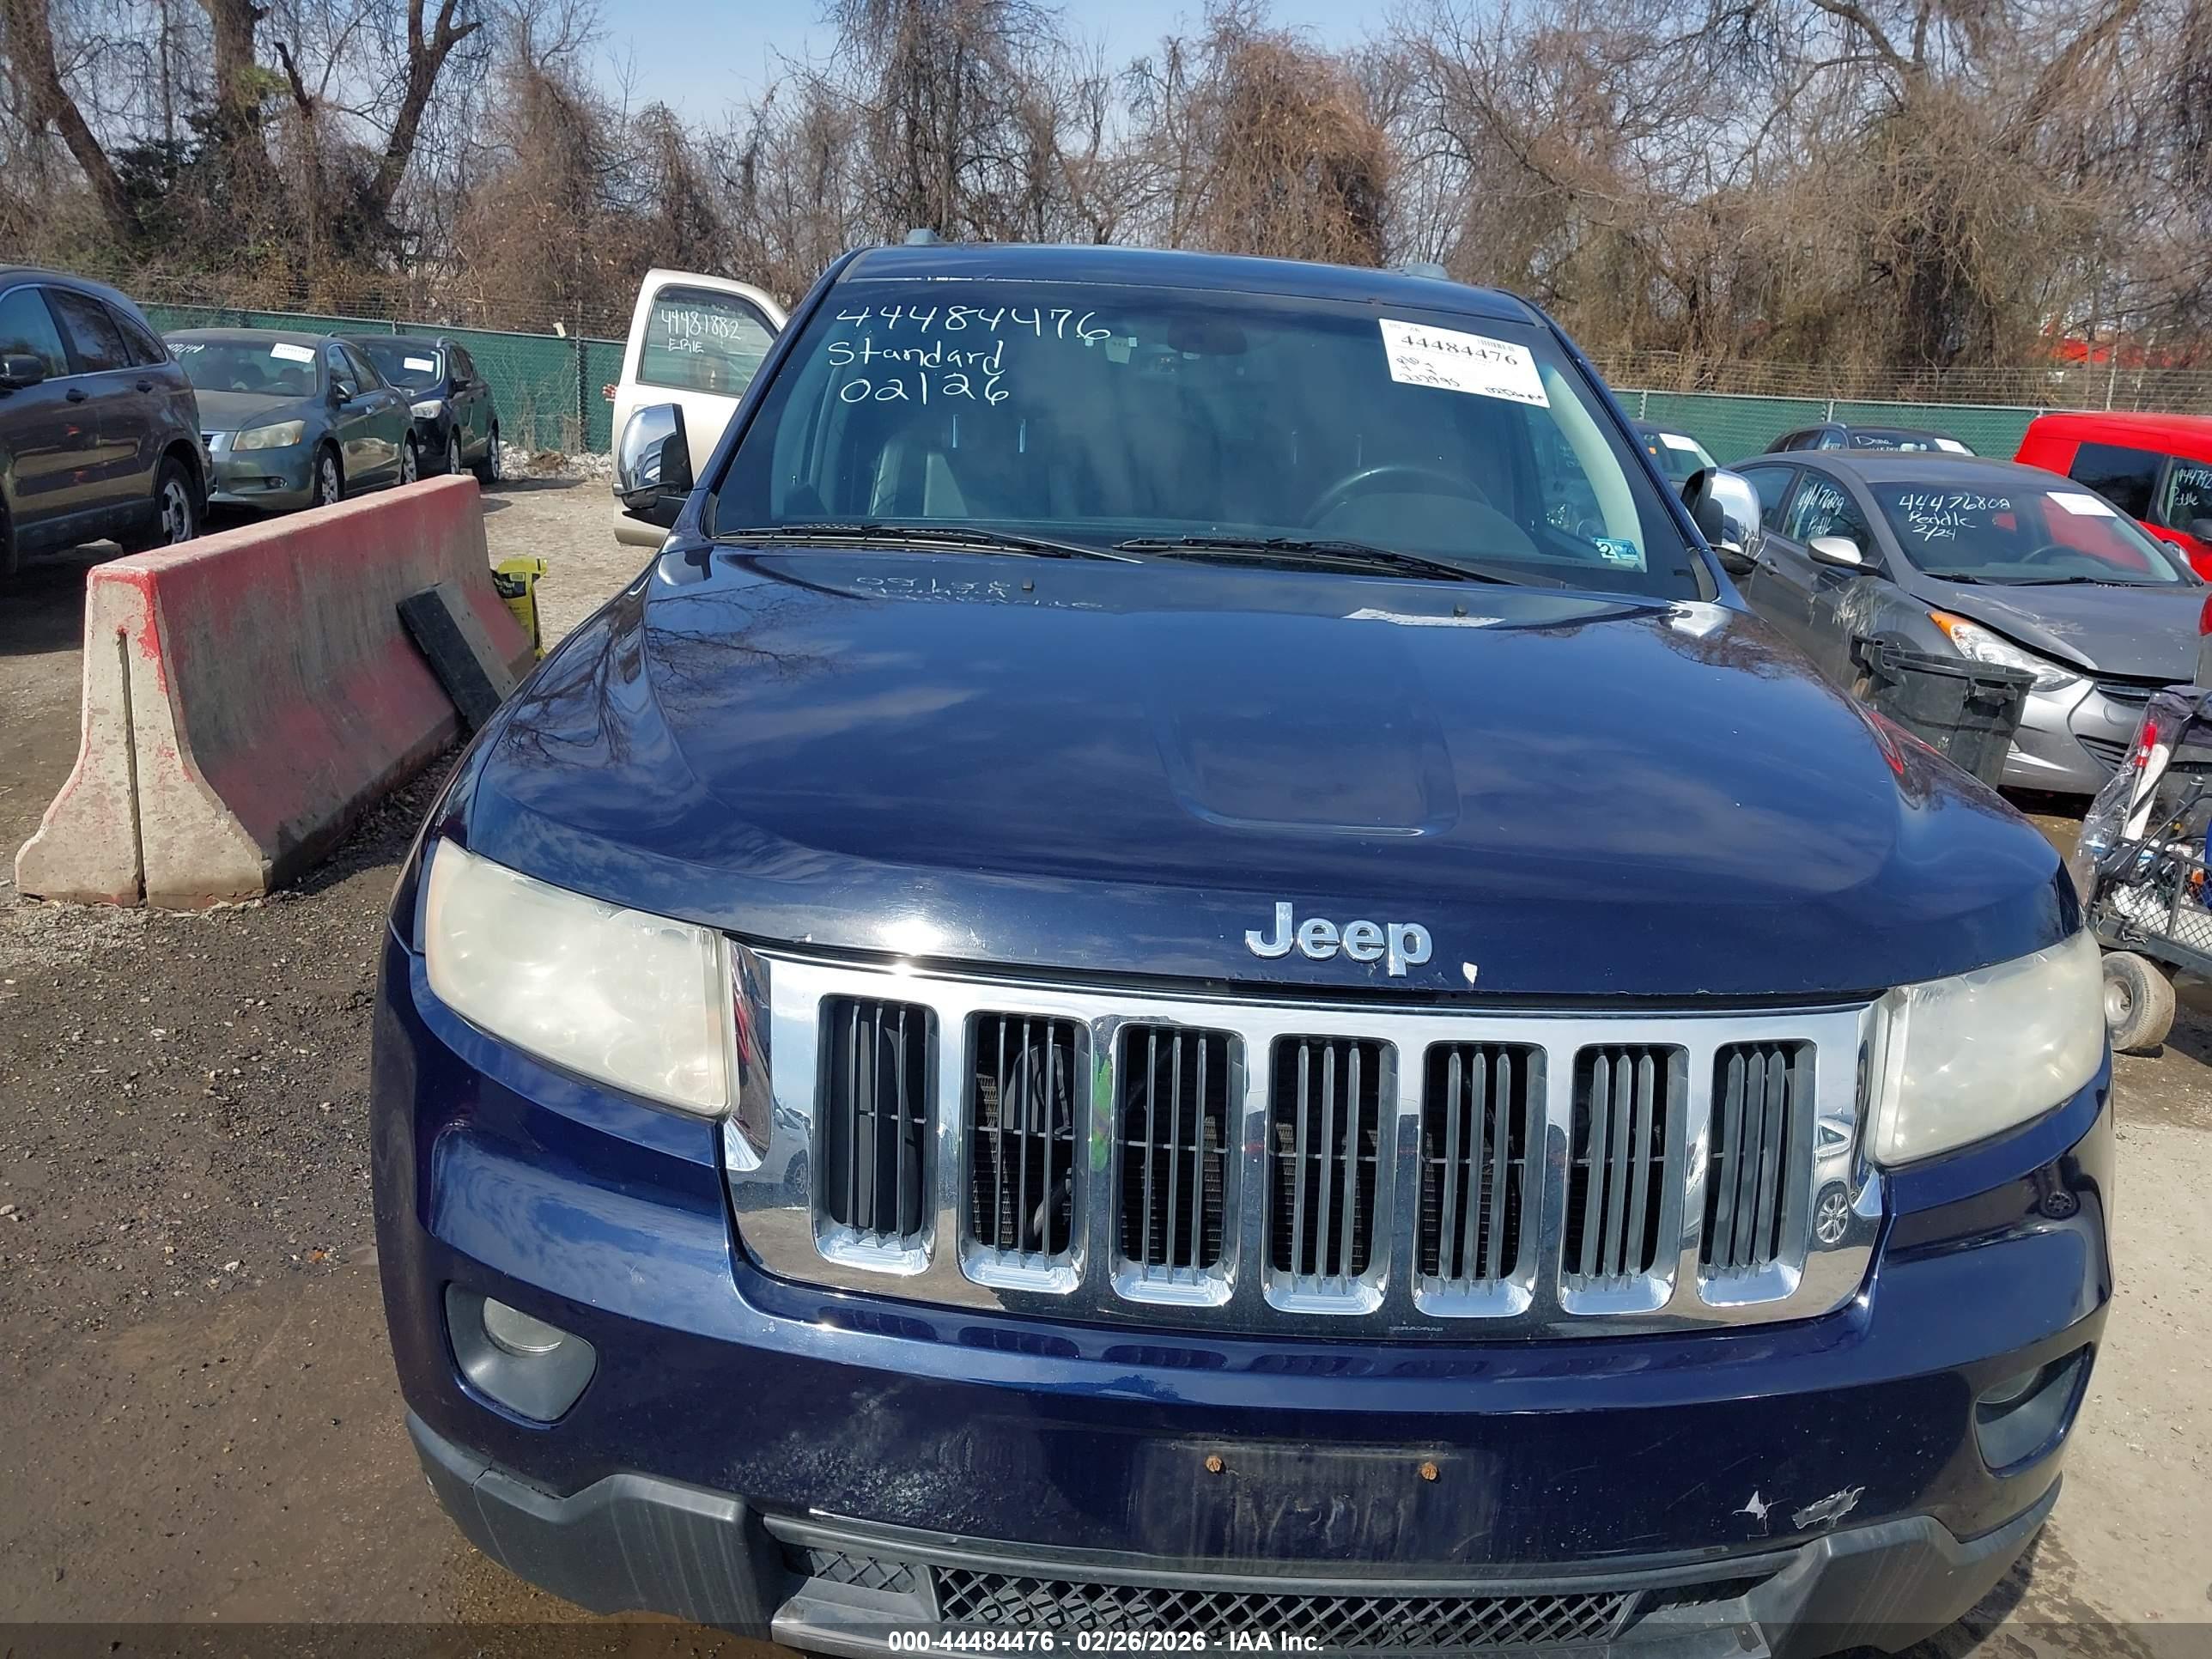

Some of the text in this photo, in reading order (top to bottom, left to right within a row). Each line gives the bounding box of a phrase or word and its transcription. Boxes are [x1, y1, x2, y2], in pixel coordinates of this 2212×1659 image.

[661, 309, 741, 340] 44481882
[836, 305, 1111, 341] 44484476
[668, 337, 704, 354] ERIE
[827, 337, 1006, 376] Standard
[1401, 334, 1518, 366] 44484476
[1245, 902, 1433, 977] Jeep
